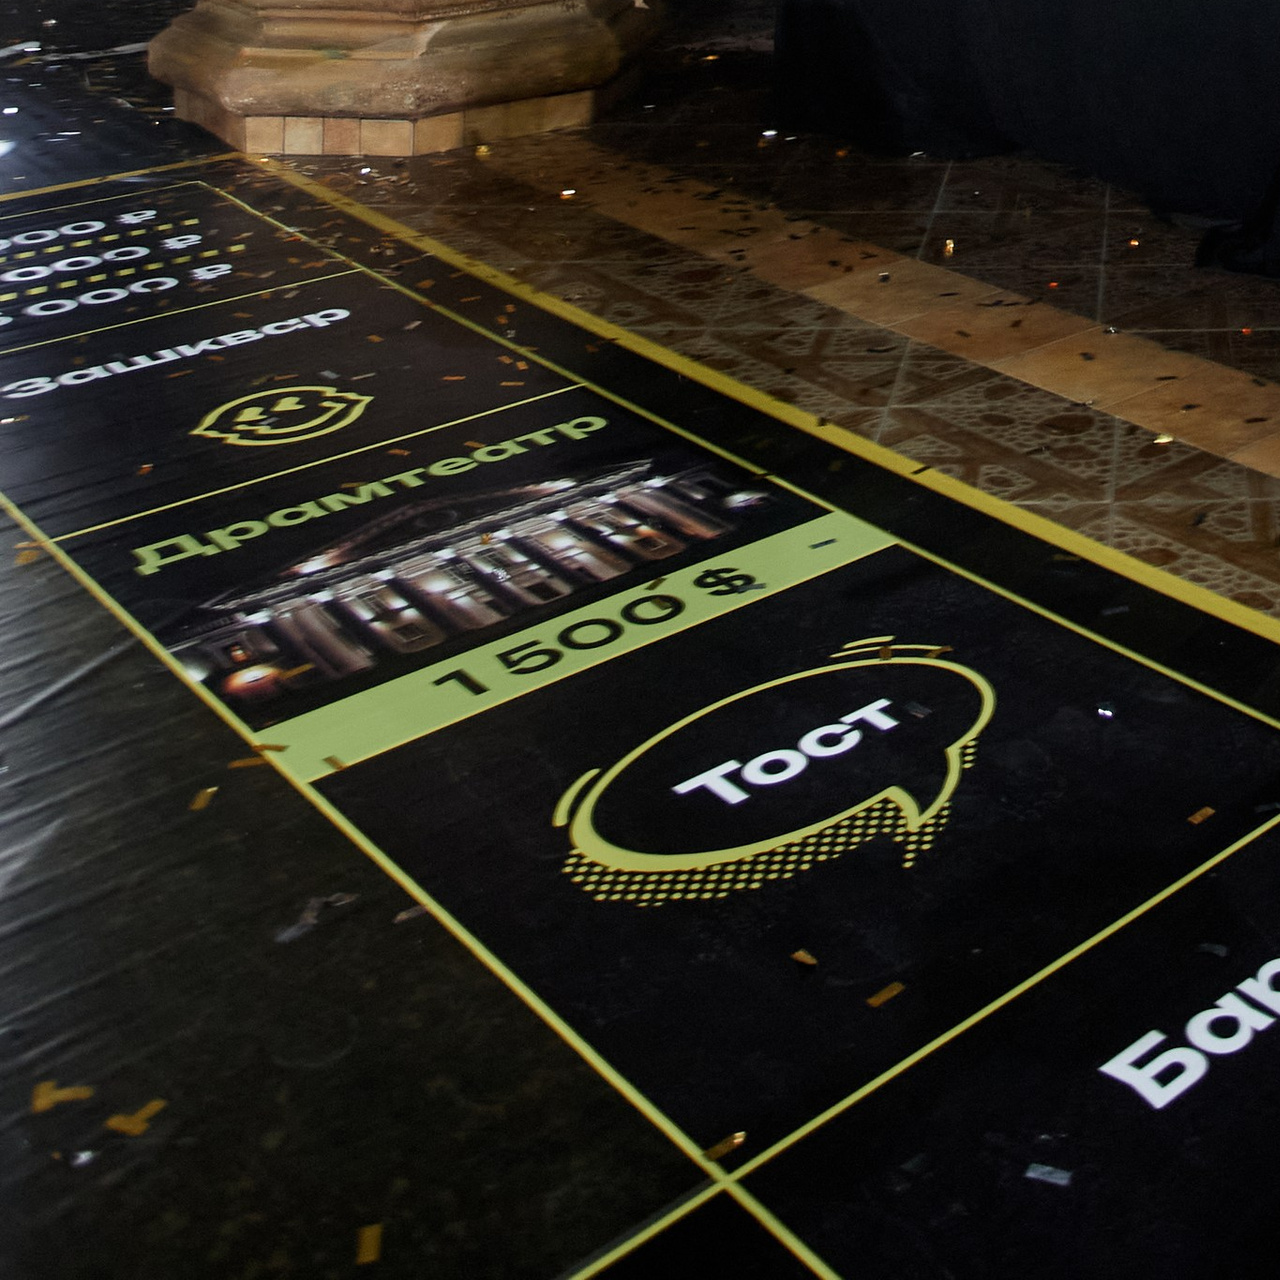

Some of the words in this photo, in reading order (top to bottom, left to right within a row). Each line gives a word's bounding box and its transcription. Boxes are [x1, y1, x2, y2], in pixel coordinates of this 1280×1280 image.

[0, 308, 352, 400] Зашквар
[130, 413, 611, 578] Драмтеатр
[670, 697, 900, 808] Тост
